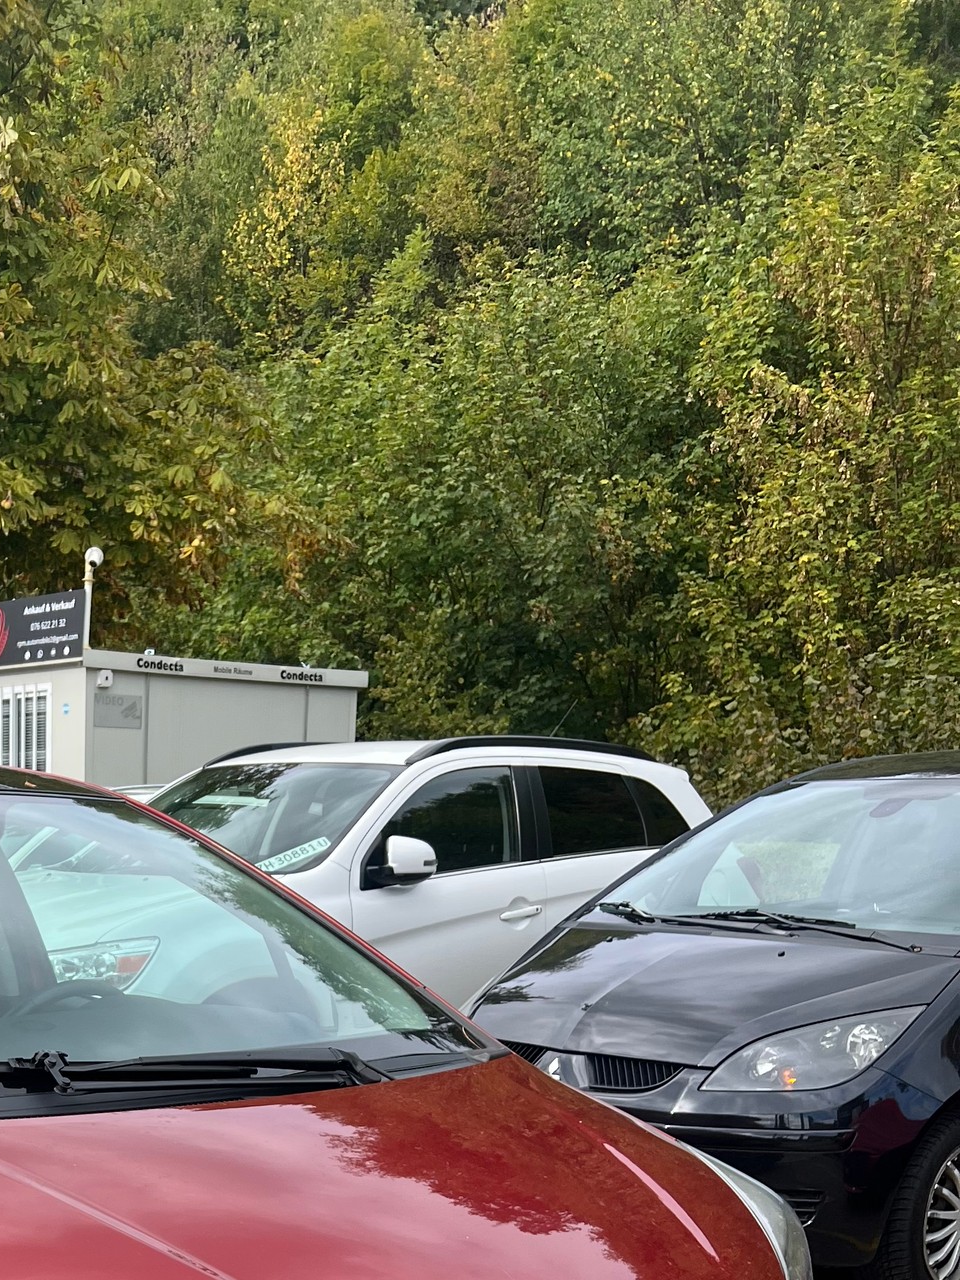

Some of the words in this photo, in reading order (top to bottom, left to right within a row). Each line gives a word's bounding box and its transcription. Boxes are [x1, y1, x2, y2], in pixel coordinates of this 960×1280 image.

[23, 602, 45, 615] Ankauf
[45, 603, 50, 612] &
[51, 598, 75, 611] Verkauf
[136, 657, 184, 673] Condecta
[213, 665, 232, 675] Mobile
[280, 669, 323, 682] Condecta
[275, 843, 317, 865] 30881
